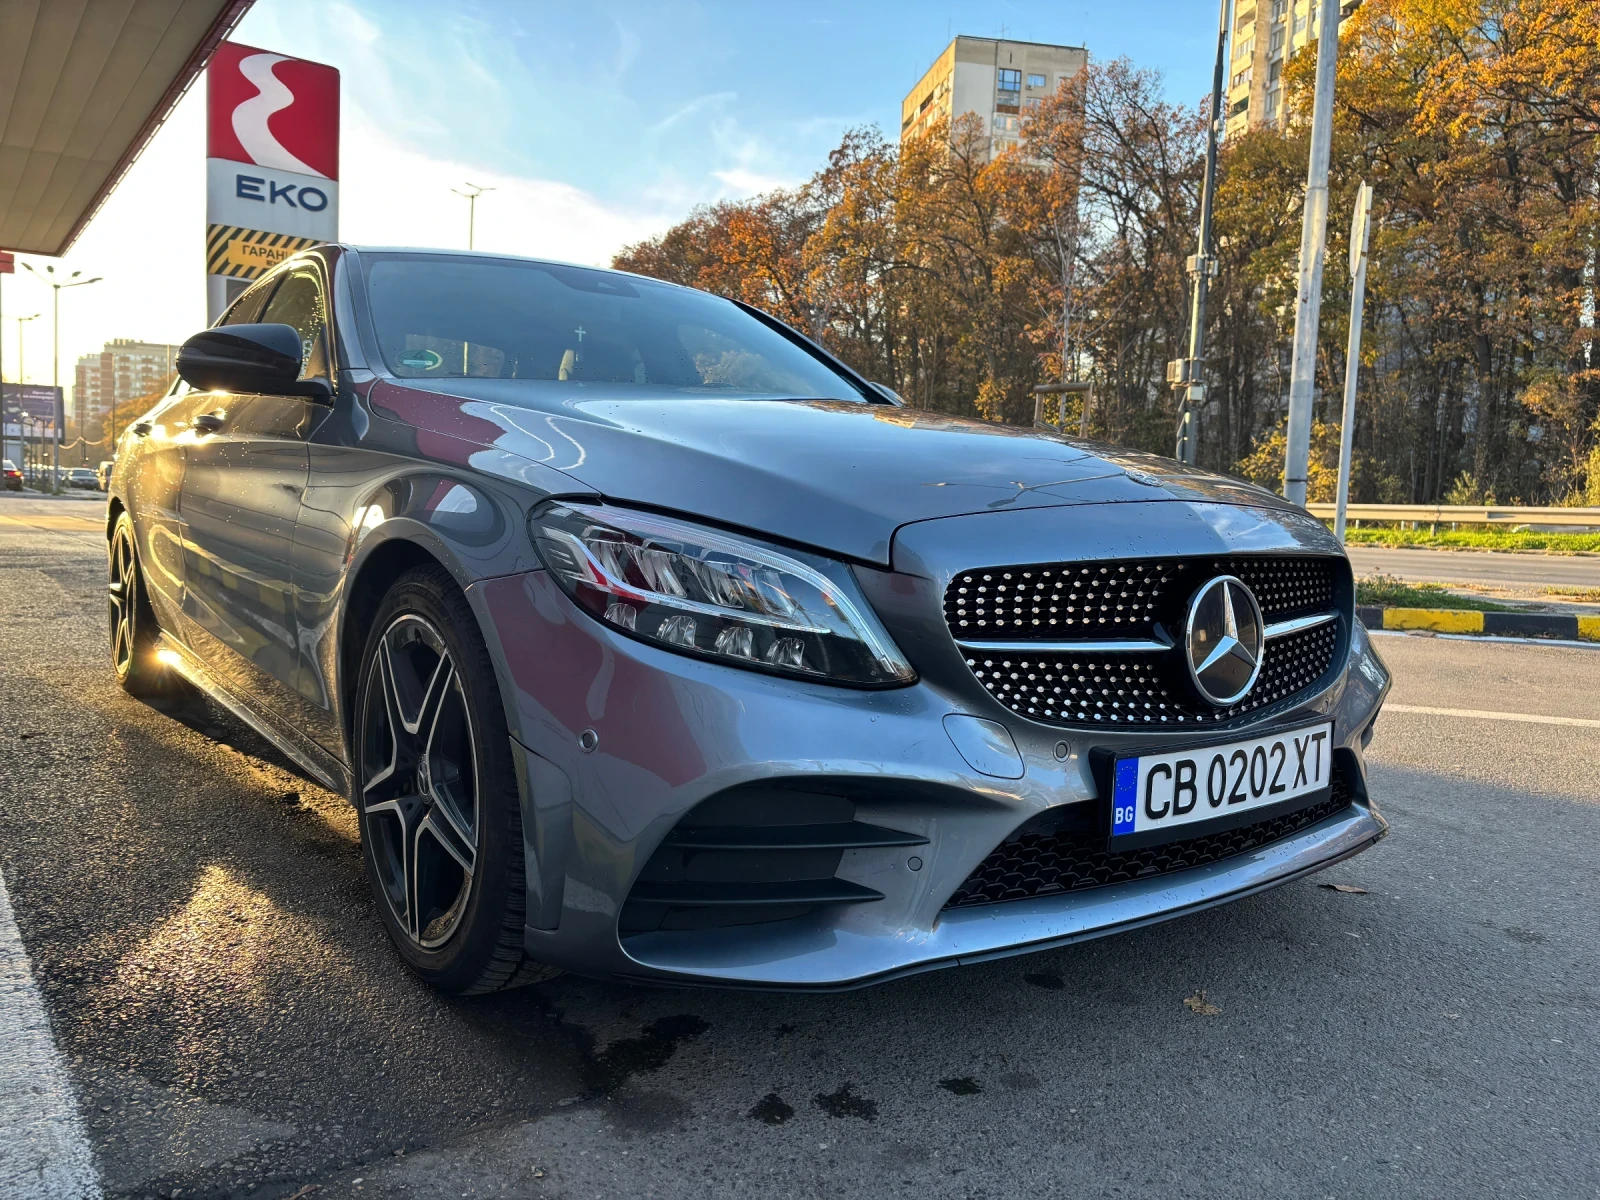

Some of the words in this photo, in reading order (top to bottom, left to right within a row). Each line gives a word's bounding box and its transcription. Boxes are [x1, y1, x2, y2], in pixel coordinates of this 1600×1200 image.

[236, 174, 328, 212] EKO
[1144, 759, 1198, 820] CB
[1207, 741, 1287, 808] 0202
[1292, 731, 1327, 790] XT
[1115, 806, 1134, 825] BG
